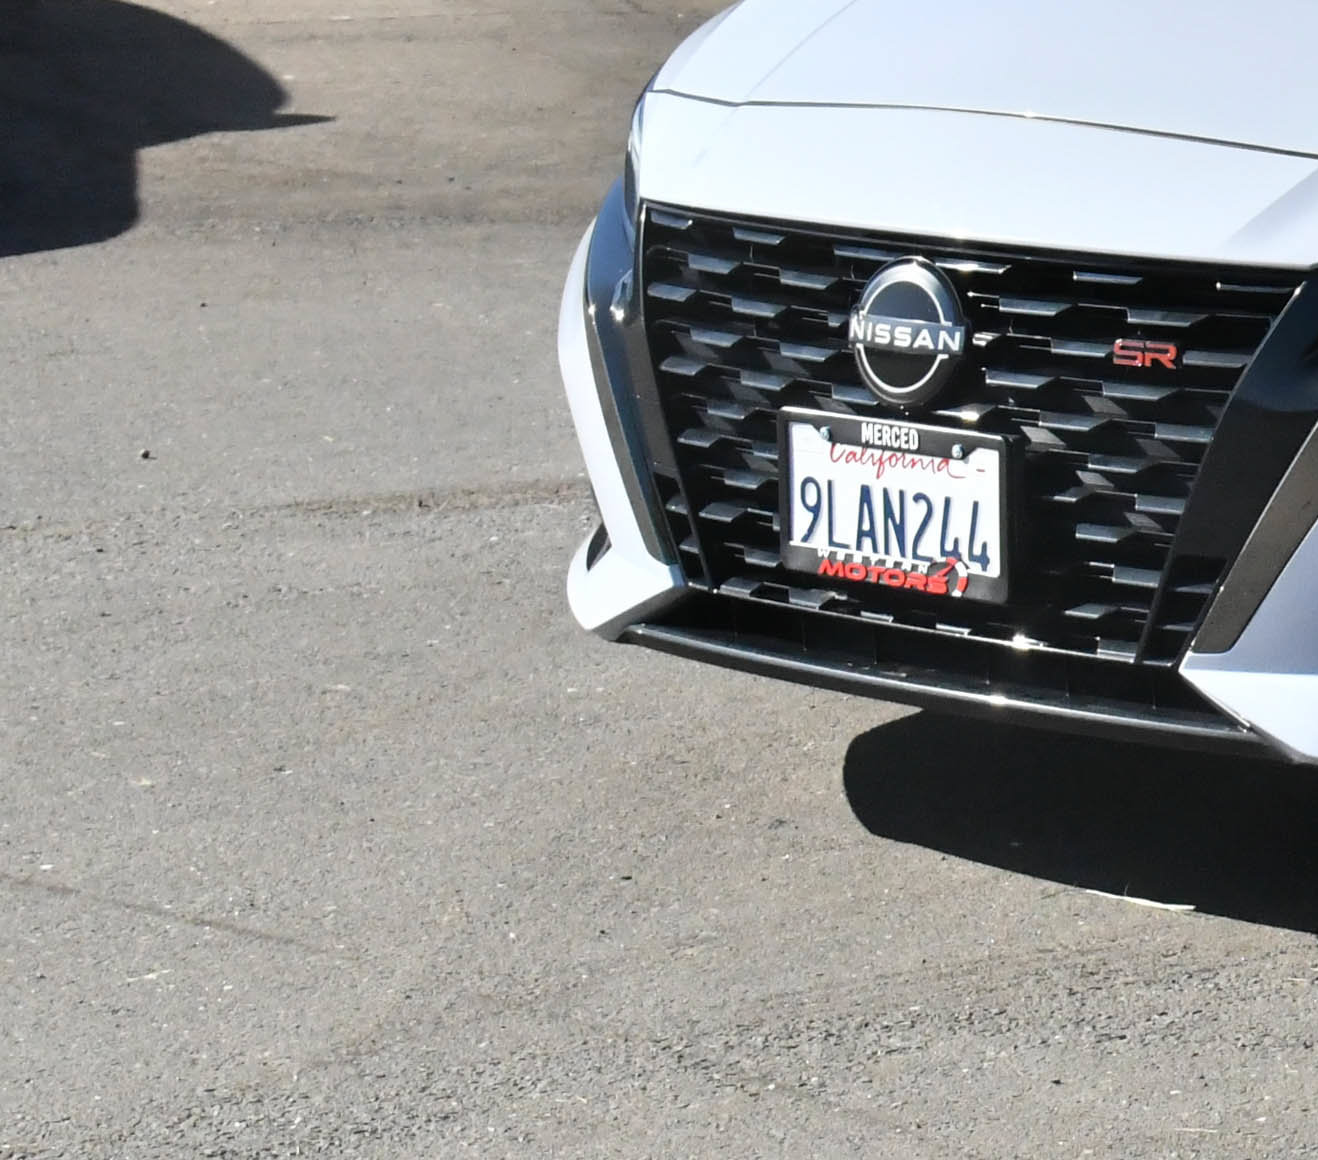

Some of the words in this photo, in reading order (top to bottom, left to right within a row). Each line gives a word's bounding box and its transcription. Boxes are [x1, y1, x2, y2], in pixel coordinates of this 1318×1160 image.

[849, 313, 961, 352] NISSAN
[1113, 338, 1177, 369] SR
[860, 422, 920, 451] MERCED
[829, 442, 967, 480] California
[799, 476, 991, 572] 9LAN244
[817, 557, 949, 596] MOTORS
